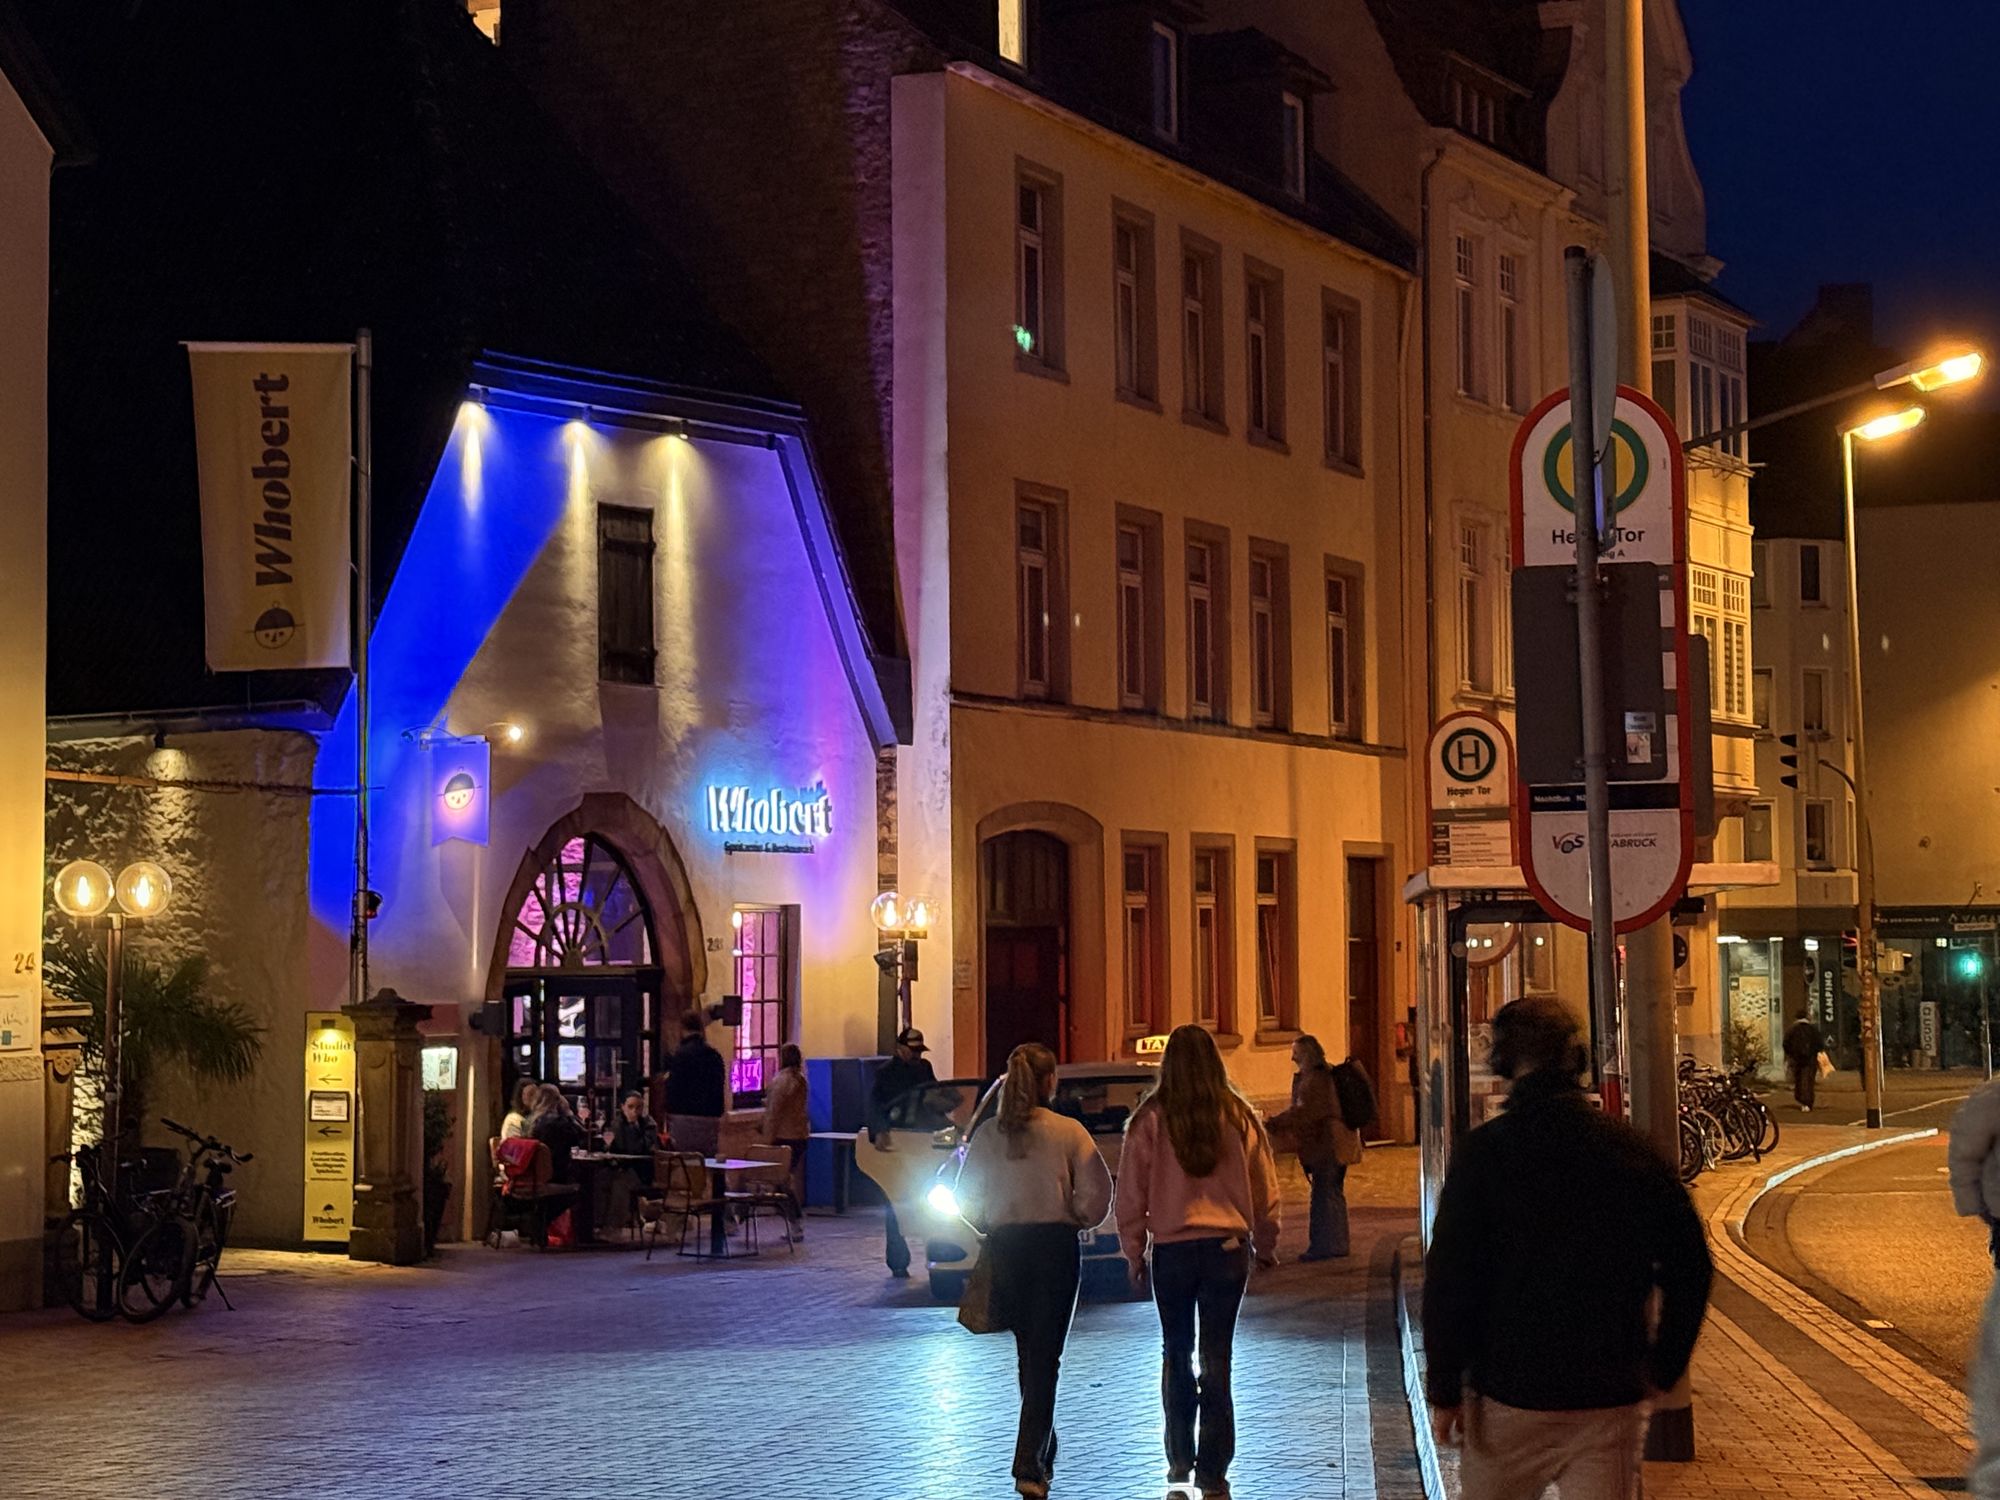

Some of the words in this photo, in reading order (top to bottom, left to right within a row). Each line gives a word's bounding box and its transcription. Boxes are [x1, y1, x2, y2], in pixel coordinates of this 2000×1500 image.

[252, 372, 293, 587] Whobert
[1616, 528, 1646, 543] Tor
[1446, 786, 1475, 798] Heger
[1476, 785, 1491, 796] Tor
[706, 785, 833, 837] Whobert
[1610, 837, 1657, 849] ABRÜCK
[1824, 970, 1835, 1021] CAMPING
[311, 1039, 351, 1051] Studio
[312, 1052, 338, 1063] Who
[312, 1215, 345, 1225] Whobert
